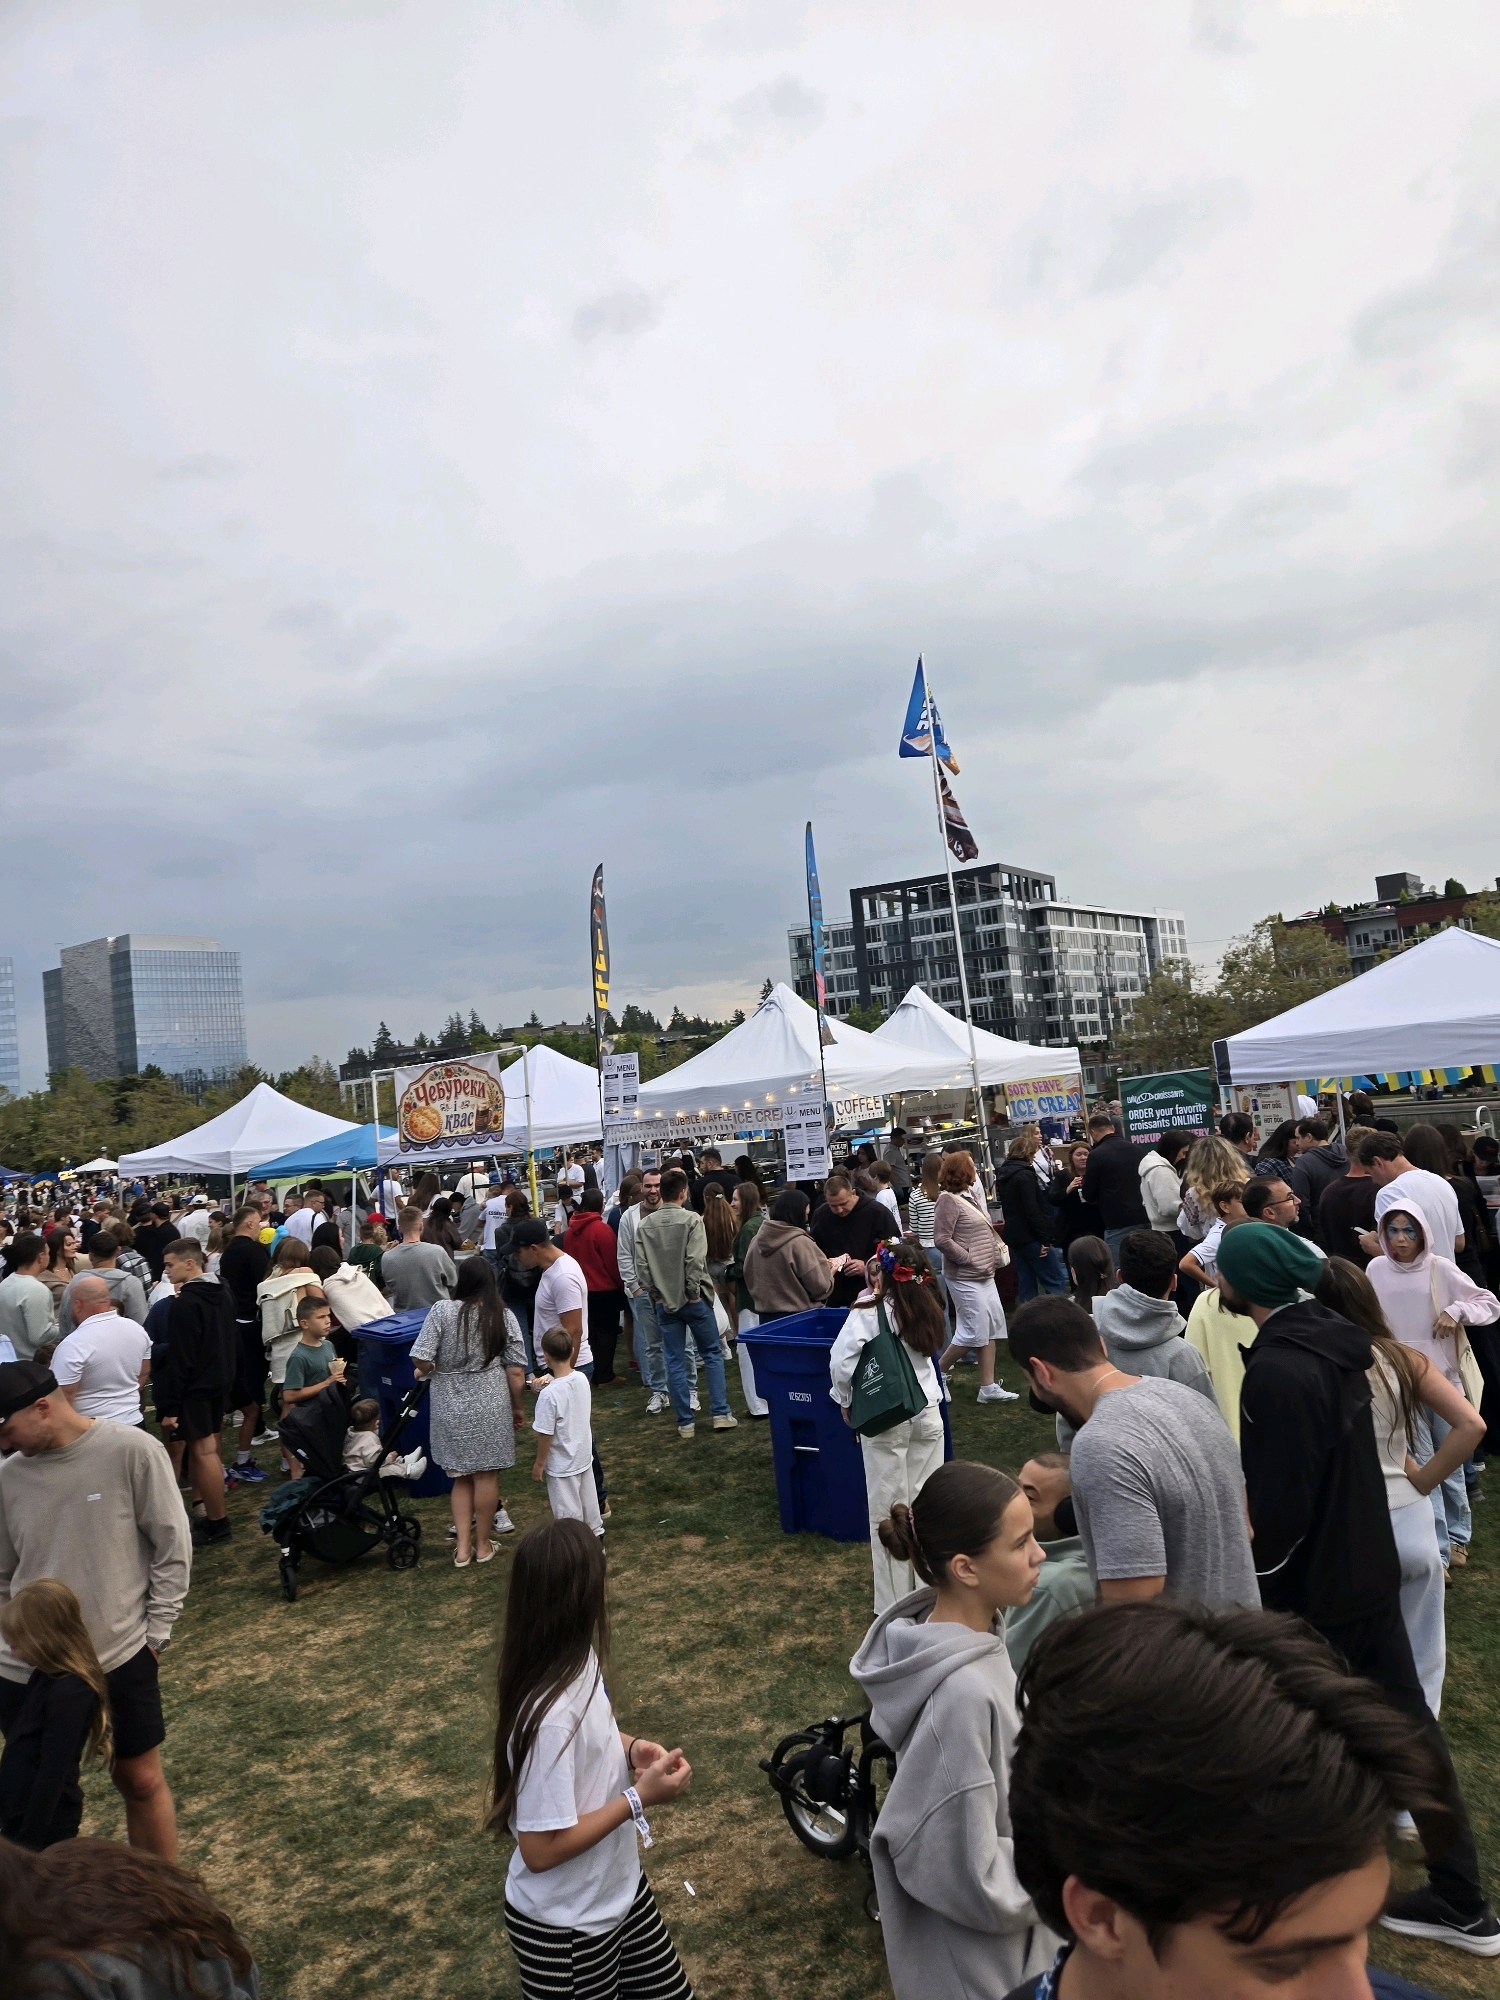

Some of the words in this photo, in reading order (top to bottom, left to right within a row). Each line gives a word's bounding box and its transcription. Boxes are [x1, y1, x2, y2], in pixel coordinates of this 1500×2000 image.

[616, 1064, 635, 1072] MENU
[414, 1079, 487, 1107] Чебуреки
[1007, 1082, 1031, 1097] SOFT
[1031, 1079, 1063, 1094] SERVE
[799, 1107, 821, 1117] MENU
[836, 1095, 882, 1116] COFFEE
[943, 1102, 959, 1110] CART
[1010, 1097, 1037, 1119] ICE
[1128, 1107, 1154, 1121] ORDER
[1155, 1107, 1174, 1120] your
[1175, 1102, 1208, 1116] favorite
[669, 1114, 700, 1127] BUBBLE
[701, 1112, 732, 1124] WAFFLE
[733, 1111, 753, 1124] ICE
[1129, 1118, 1171, 1131] croissants
[1171, 1113, 1204, 1127] ONLINE!
[1130, 1132, 1162, 1144] PICKUP
